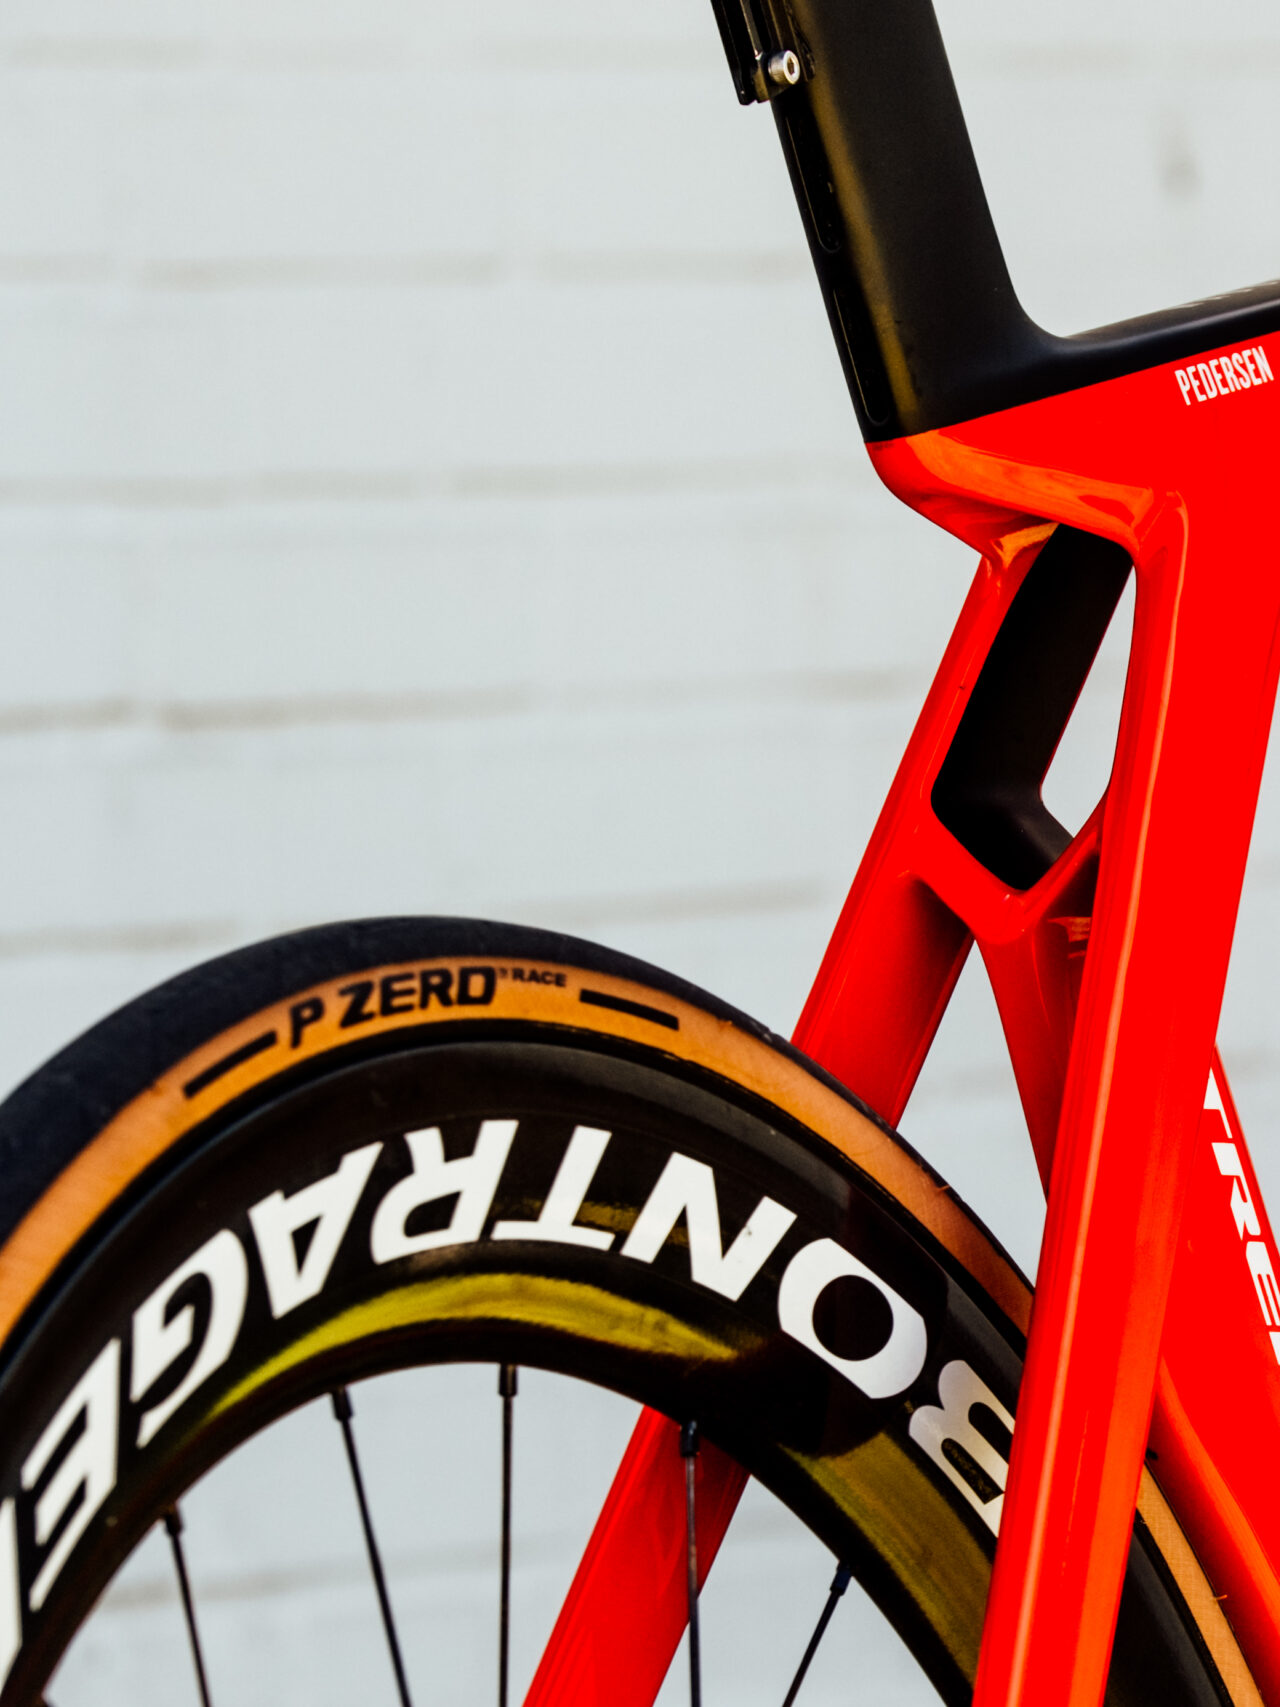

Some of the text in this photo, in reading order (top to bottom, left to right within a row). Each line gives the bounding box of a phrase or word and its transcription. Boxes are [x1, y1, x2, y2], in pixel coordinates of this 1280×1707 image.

[1174, 345, 1274, 406] PEDERSEN
[289, 996, 325, 1050] P
[511, 967, 567, 988] RACE
[0, 1119, 1016, 1698] BONTRAGE
